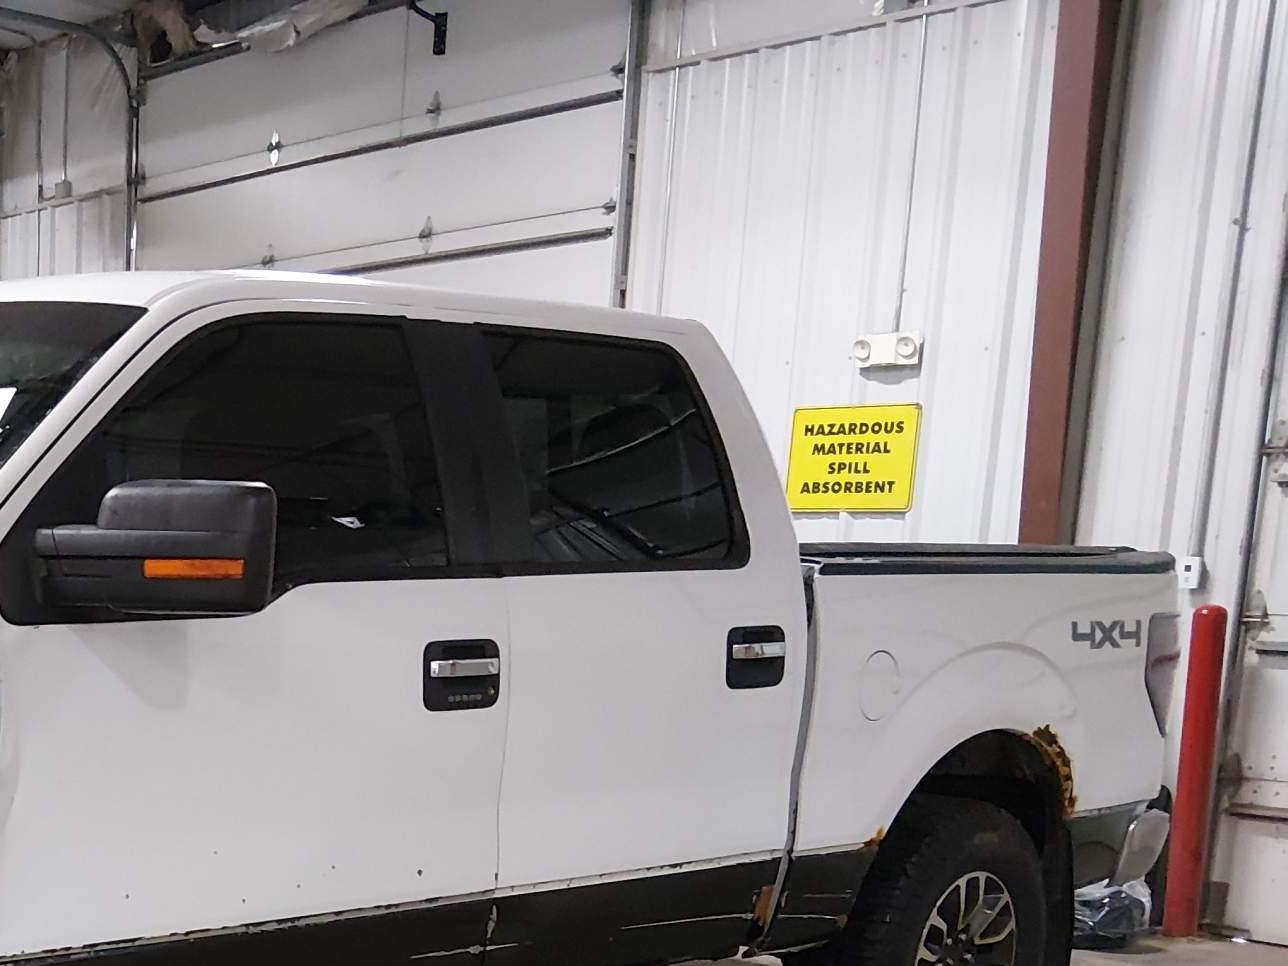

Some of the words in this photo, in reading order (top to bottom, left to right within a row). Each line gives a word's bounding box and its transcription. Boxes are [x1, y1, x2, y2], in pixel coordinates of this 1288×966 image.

[804, 420, 905, 437] HAZARDOUS
[811, 441, 891, 456] MATERIAL
[827, 461, 871, 475] SPILL
[799, 480, 896, 495] ABSORBENT
[1071, 619, 1142, 650] 4X4
